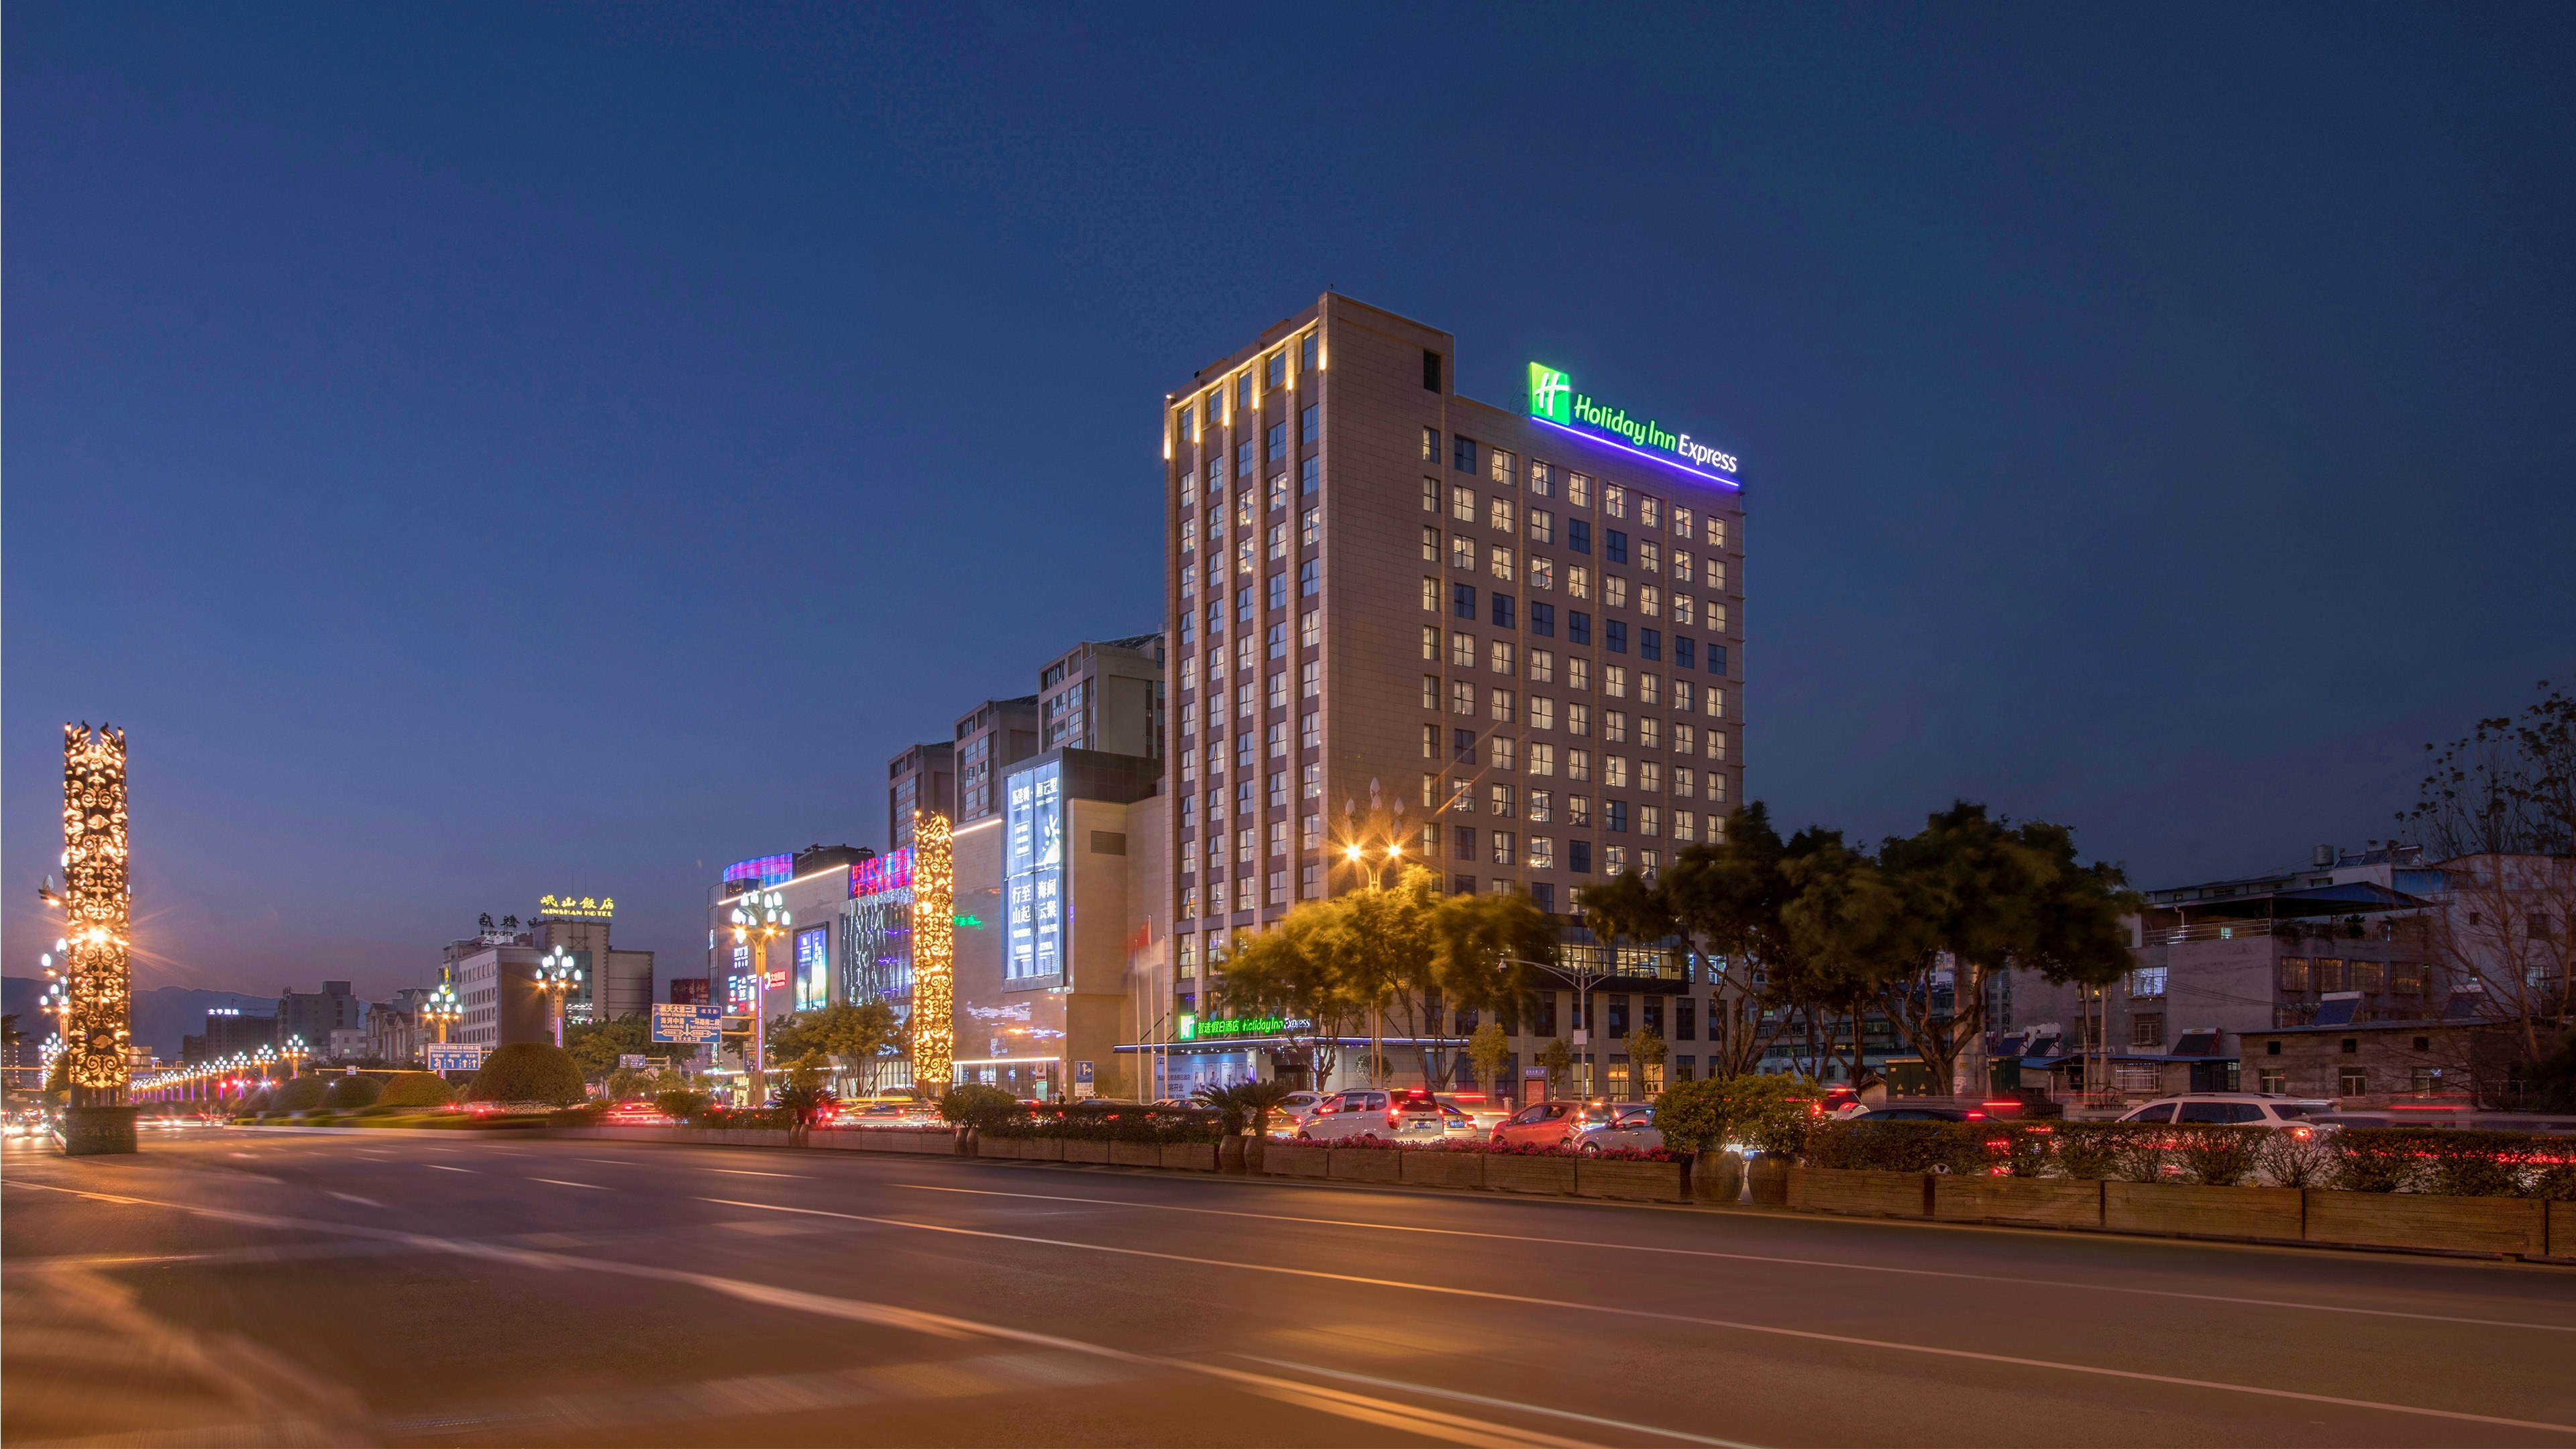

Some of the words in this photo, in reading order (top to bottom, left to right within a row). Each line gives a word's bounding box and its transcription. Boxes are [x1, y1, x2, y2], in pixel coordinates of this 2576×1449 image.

[1574, 394, 1646, 445] Holiday
[1648, 420, 1676, 451] Inn
[1678, 434, 1737, 472] Express
[852, 848, 908, 880] 时代广场
[540, 894, 614, 910] 岷山飯店
[1012, 884, 1031, 905] 行至
[1012, 905, 1031, 924] 山起
[661, 1005, 696, 1013] 航天大道二段
[1197, 1020, 1240, 1034] 智选假日酒店
[1164, 1083, 1184, 1091] 将开业
